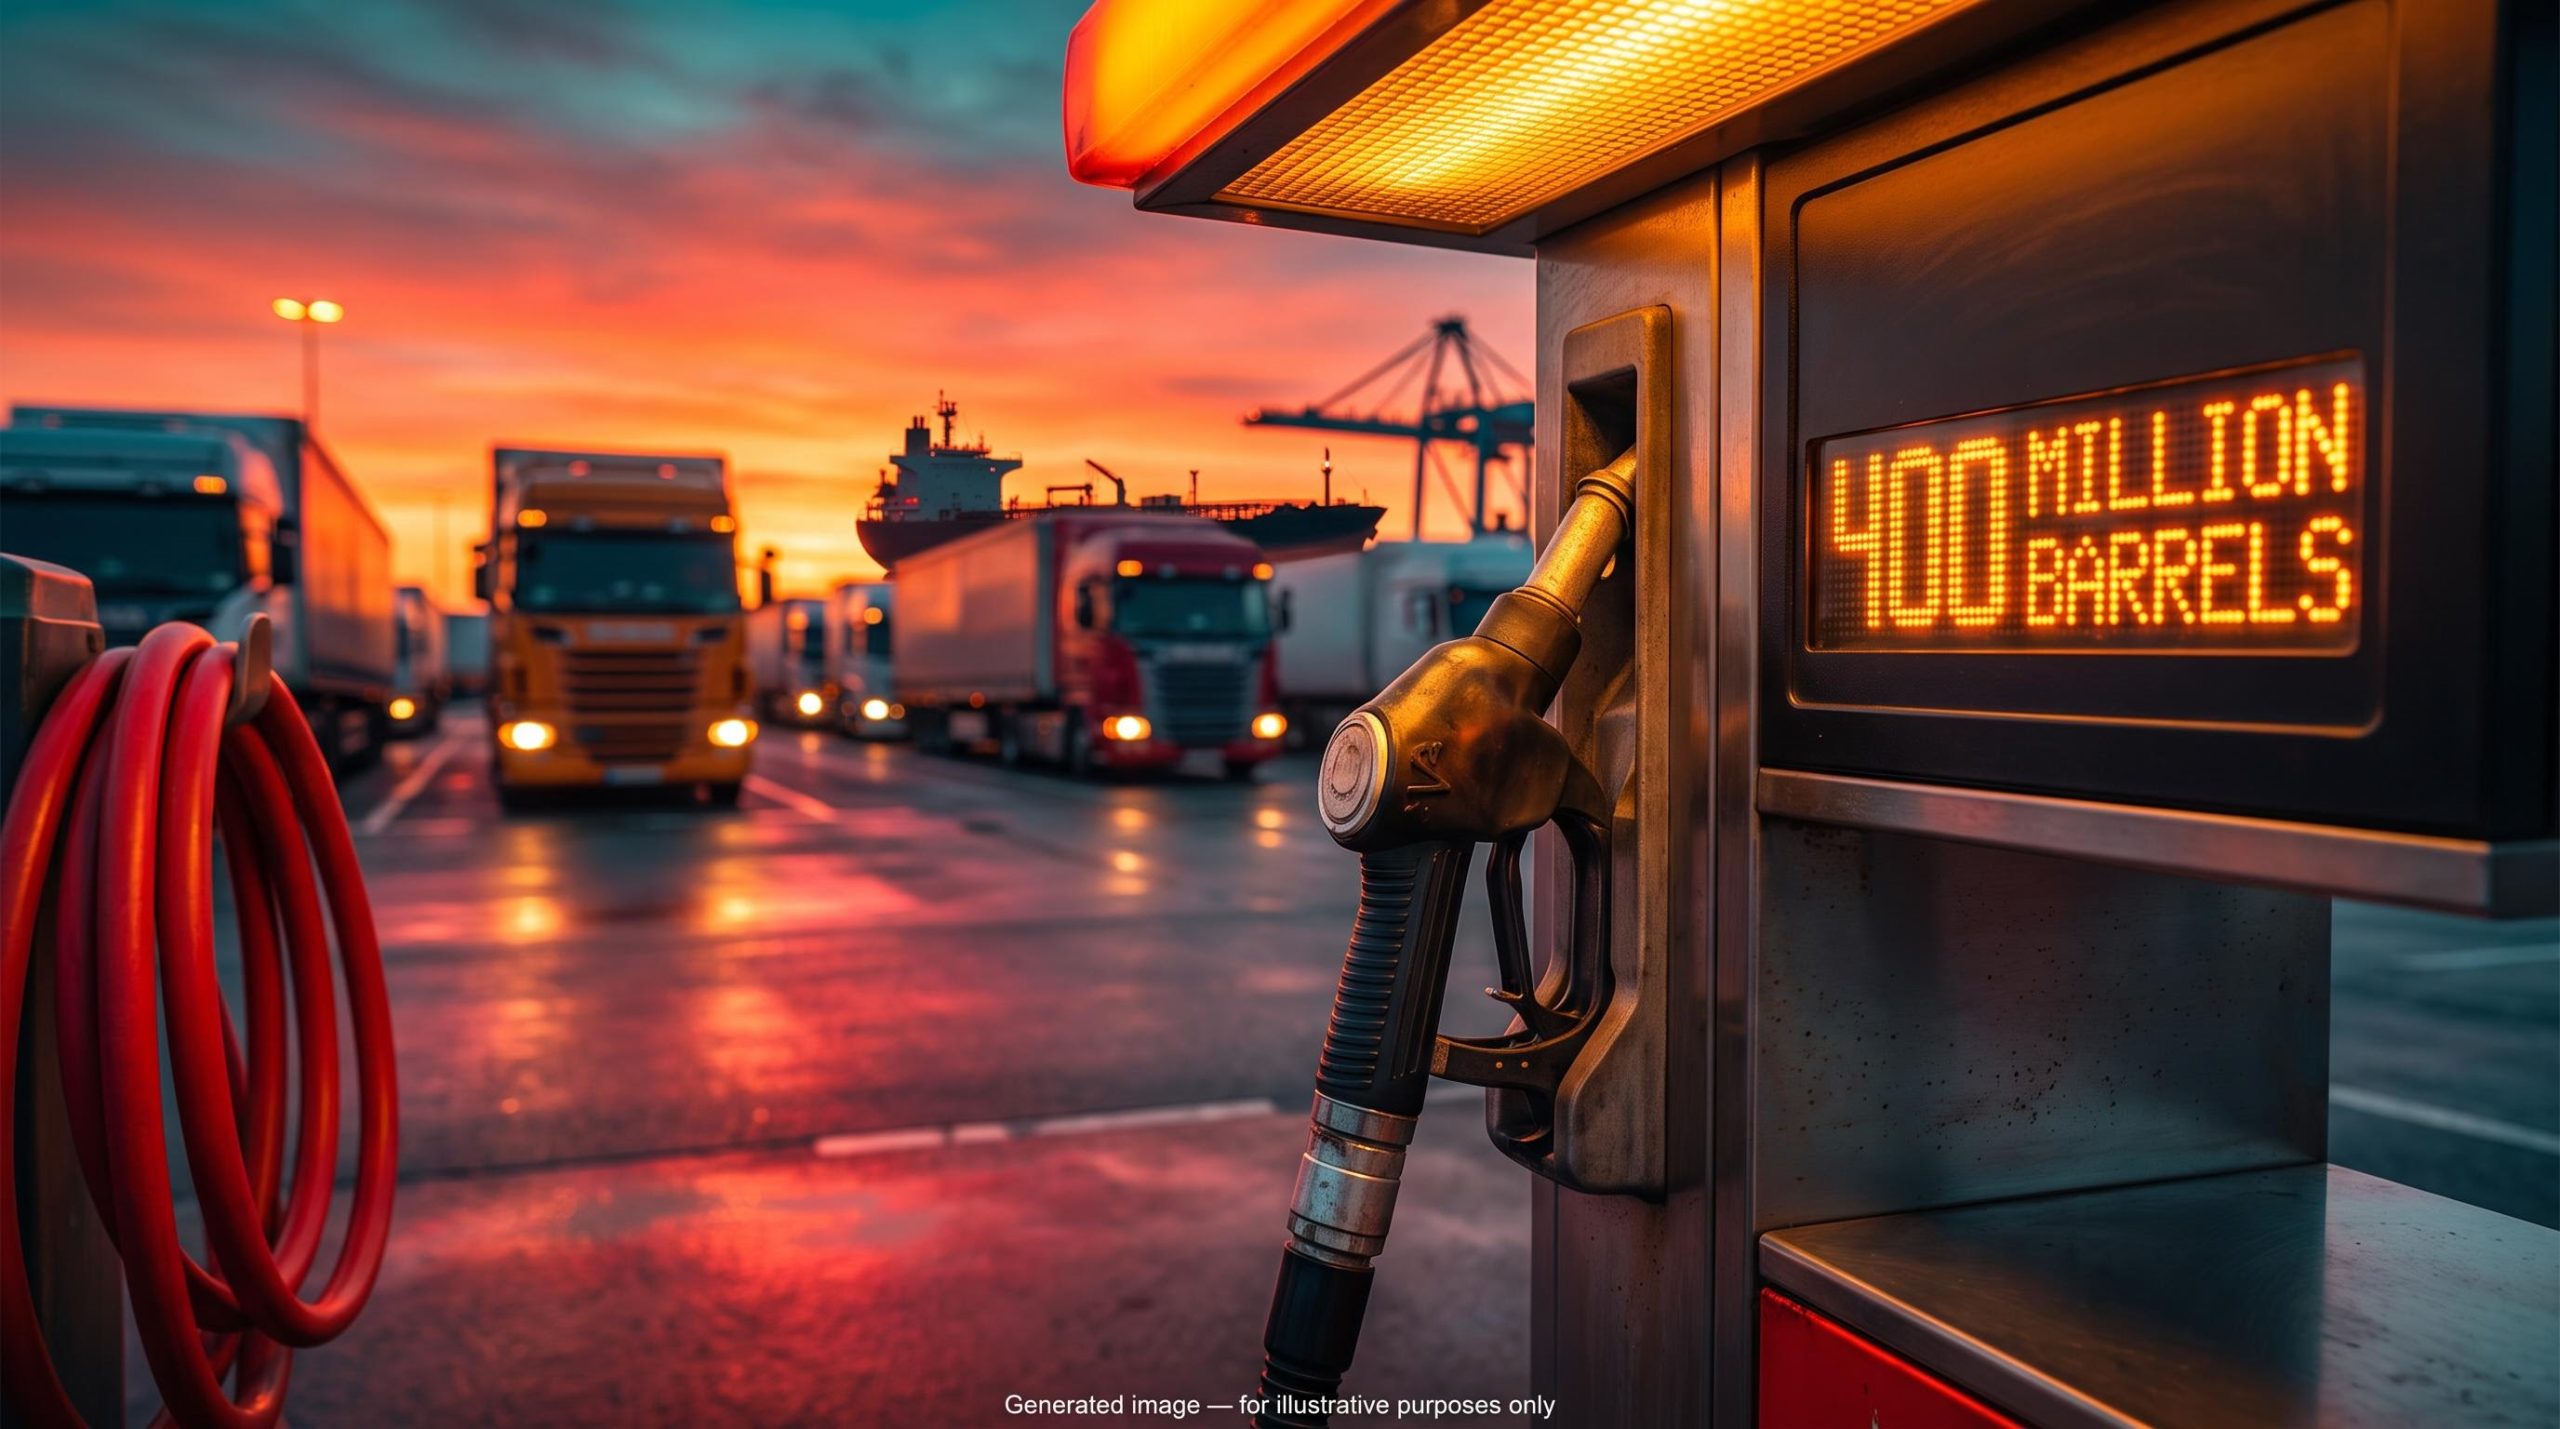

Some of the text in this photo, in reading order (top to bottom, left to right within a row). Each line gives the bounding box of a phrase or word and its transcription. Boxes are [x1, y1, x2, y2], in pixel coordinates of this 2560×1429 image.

[1833, 383, 2350, 628] 400 MILLION
[2026, 517, 2353, 627] BARRELS
